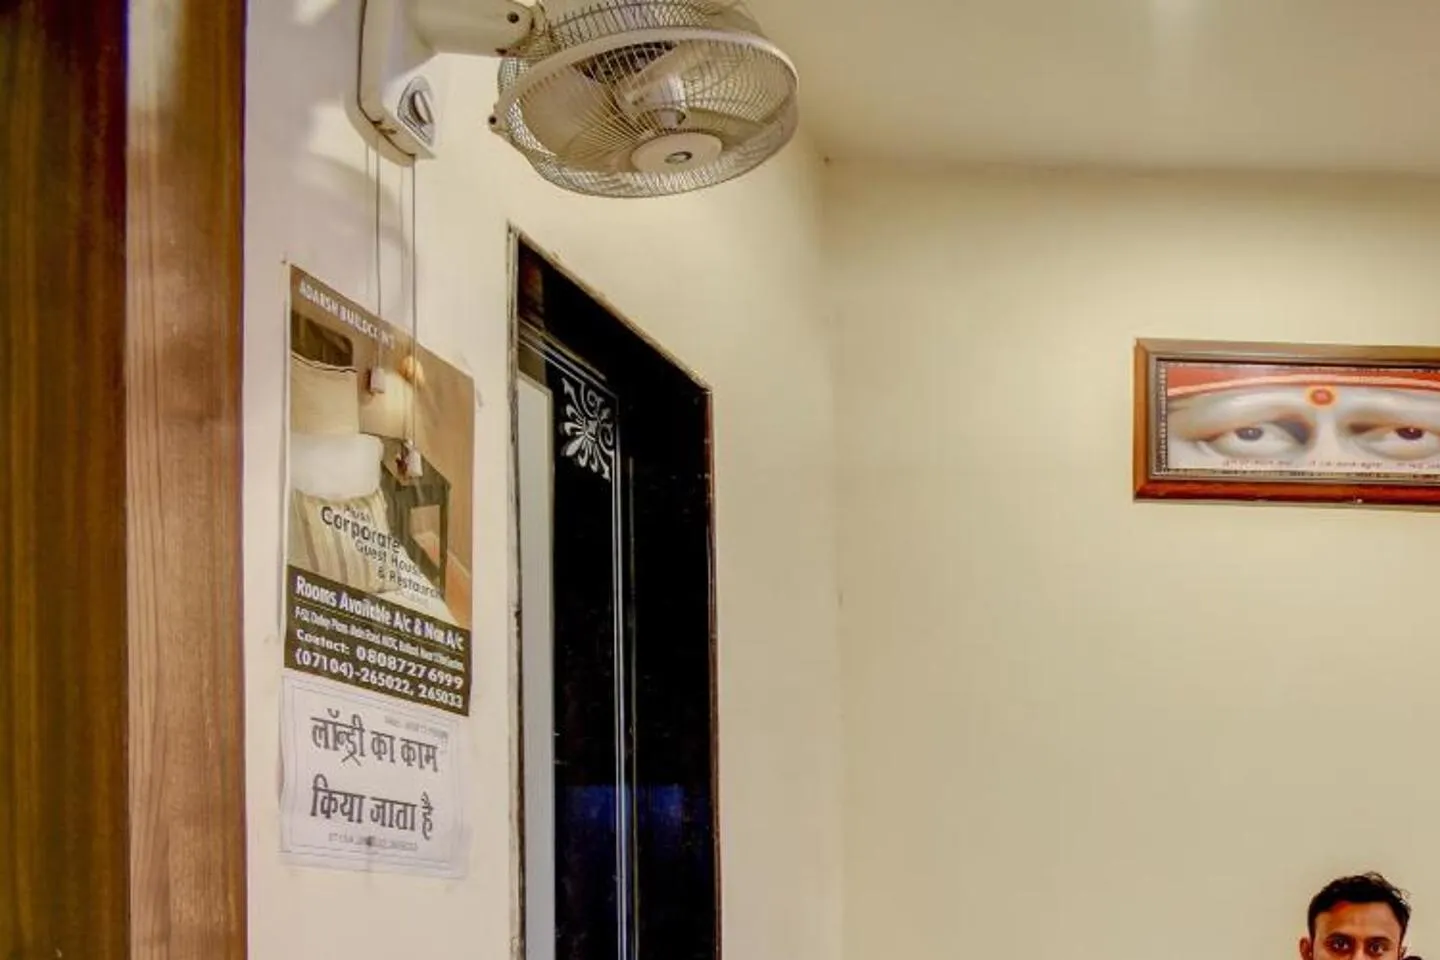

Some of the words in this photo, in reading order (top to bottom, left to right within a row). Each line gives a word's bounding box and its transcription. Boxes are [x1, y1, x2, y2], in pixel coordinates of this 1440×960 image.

[321, 506, 400, 553] Corporate
[355, 540, 386, 562] Guest
[391, 555, 421, 576] Hous
[296, 575, 338, 607] Rooms
[340, 592, 391, 626] Available
[413, 617, 422, 636] &
[296, 629, 350, 656] Contact:
[370, 730, 396, 763] का
[400, 737, 438, 773] काम
[310, 773, 366, 824] किया
[370, 796, 417, 832] जाता
[420, 791, 434, 841] है
